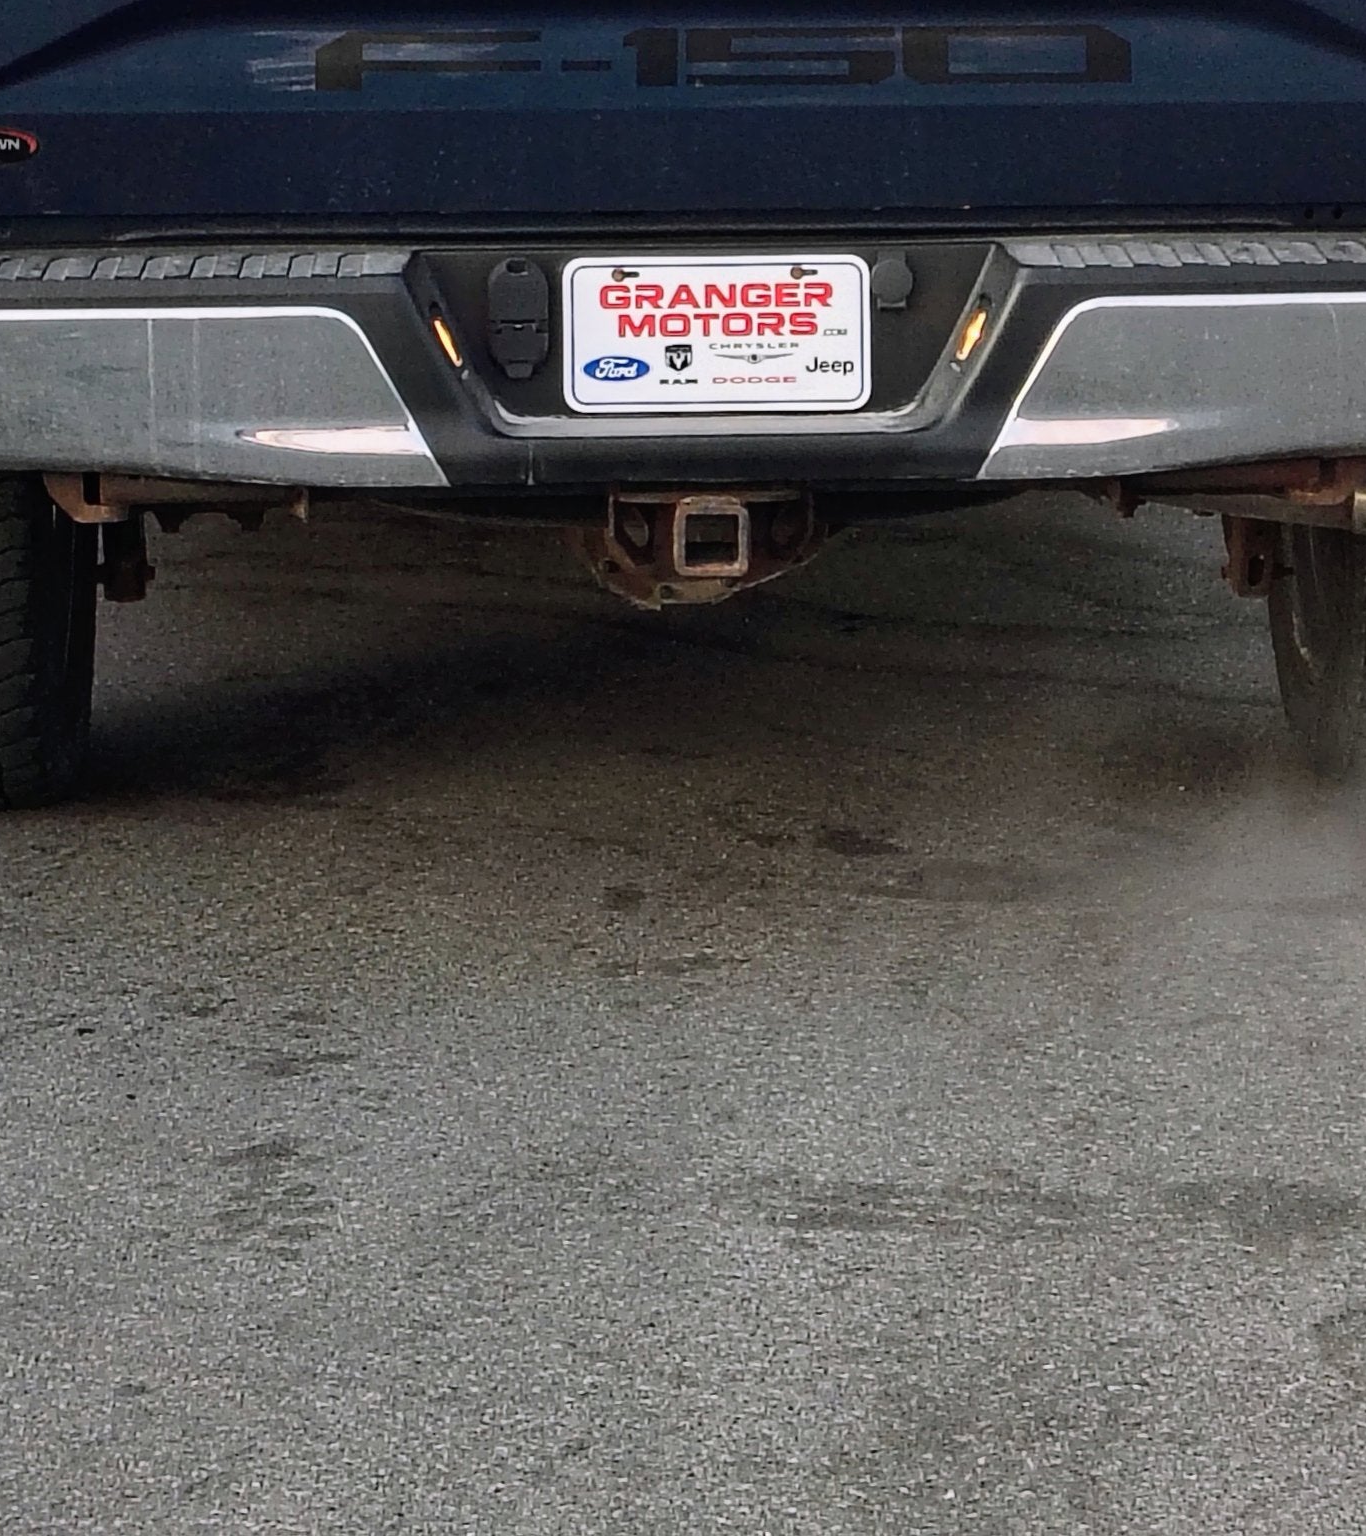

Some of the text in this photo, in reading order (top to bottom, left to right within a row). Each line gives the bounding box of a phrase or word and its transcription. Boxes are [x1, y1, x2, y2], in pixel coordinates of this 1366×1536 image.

[315, 24, 1133, 92] F-150
[599, 282, 833, 310] GRANGER
[617, 312, 818, 338] MOTORS
[708, 342, 800, 350] CHRYSLER
[595, 357, 639, 379] Ford
[805, 357, 855, 376] Jeep
[711, 376, 798, 385] DODGE
